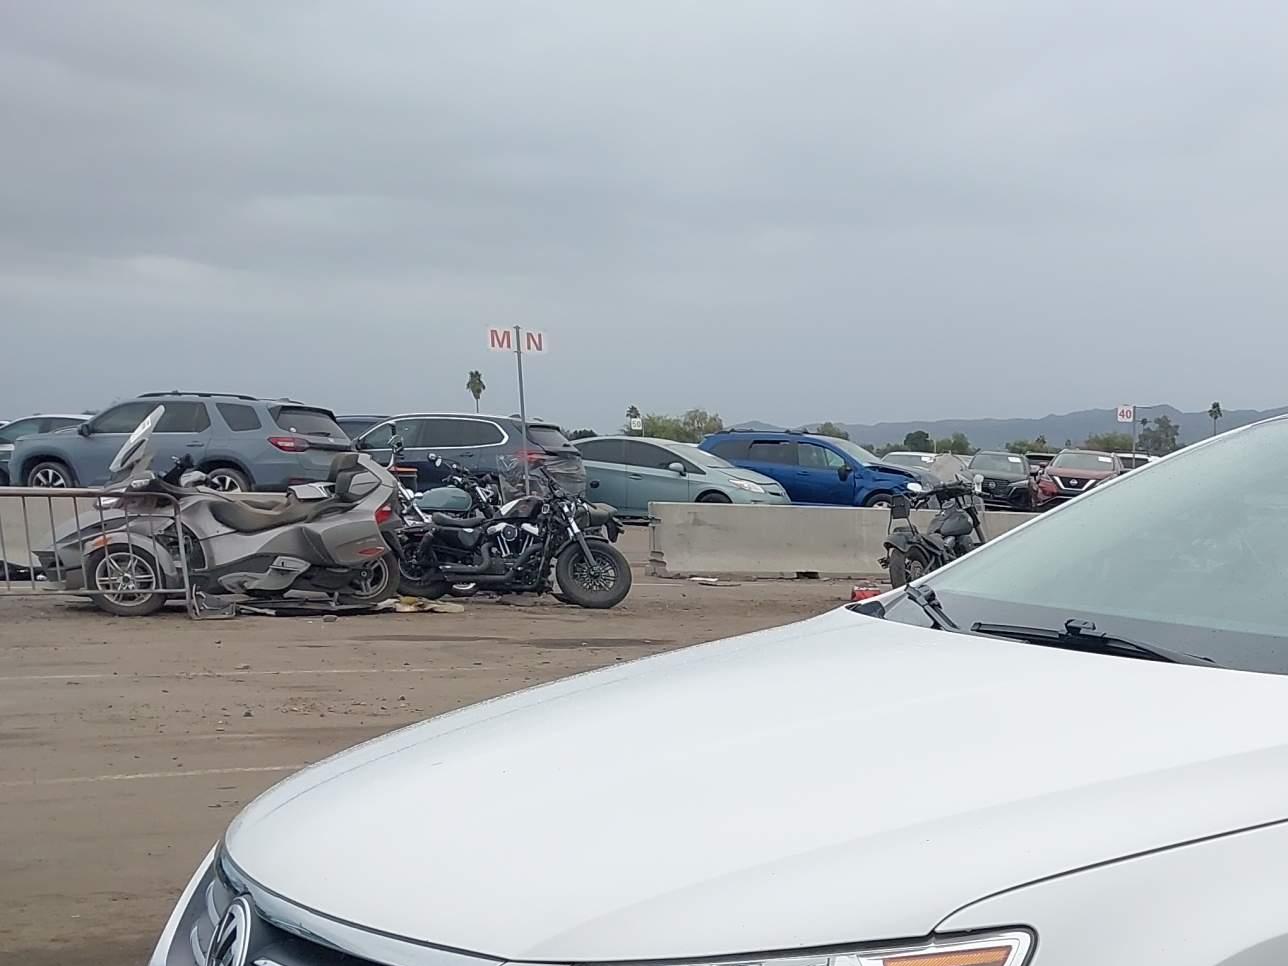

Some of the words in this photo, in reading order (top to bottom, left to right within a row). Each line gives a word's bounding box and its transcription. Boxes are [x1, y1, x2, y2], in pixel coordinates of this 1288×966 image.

[490, 329, 511, 349] M
[526, 331, 543, 352] N
[1118, 409, 1132, 419] 40
